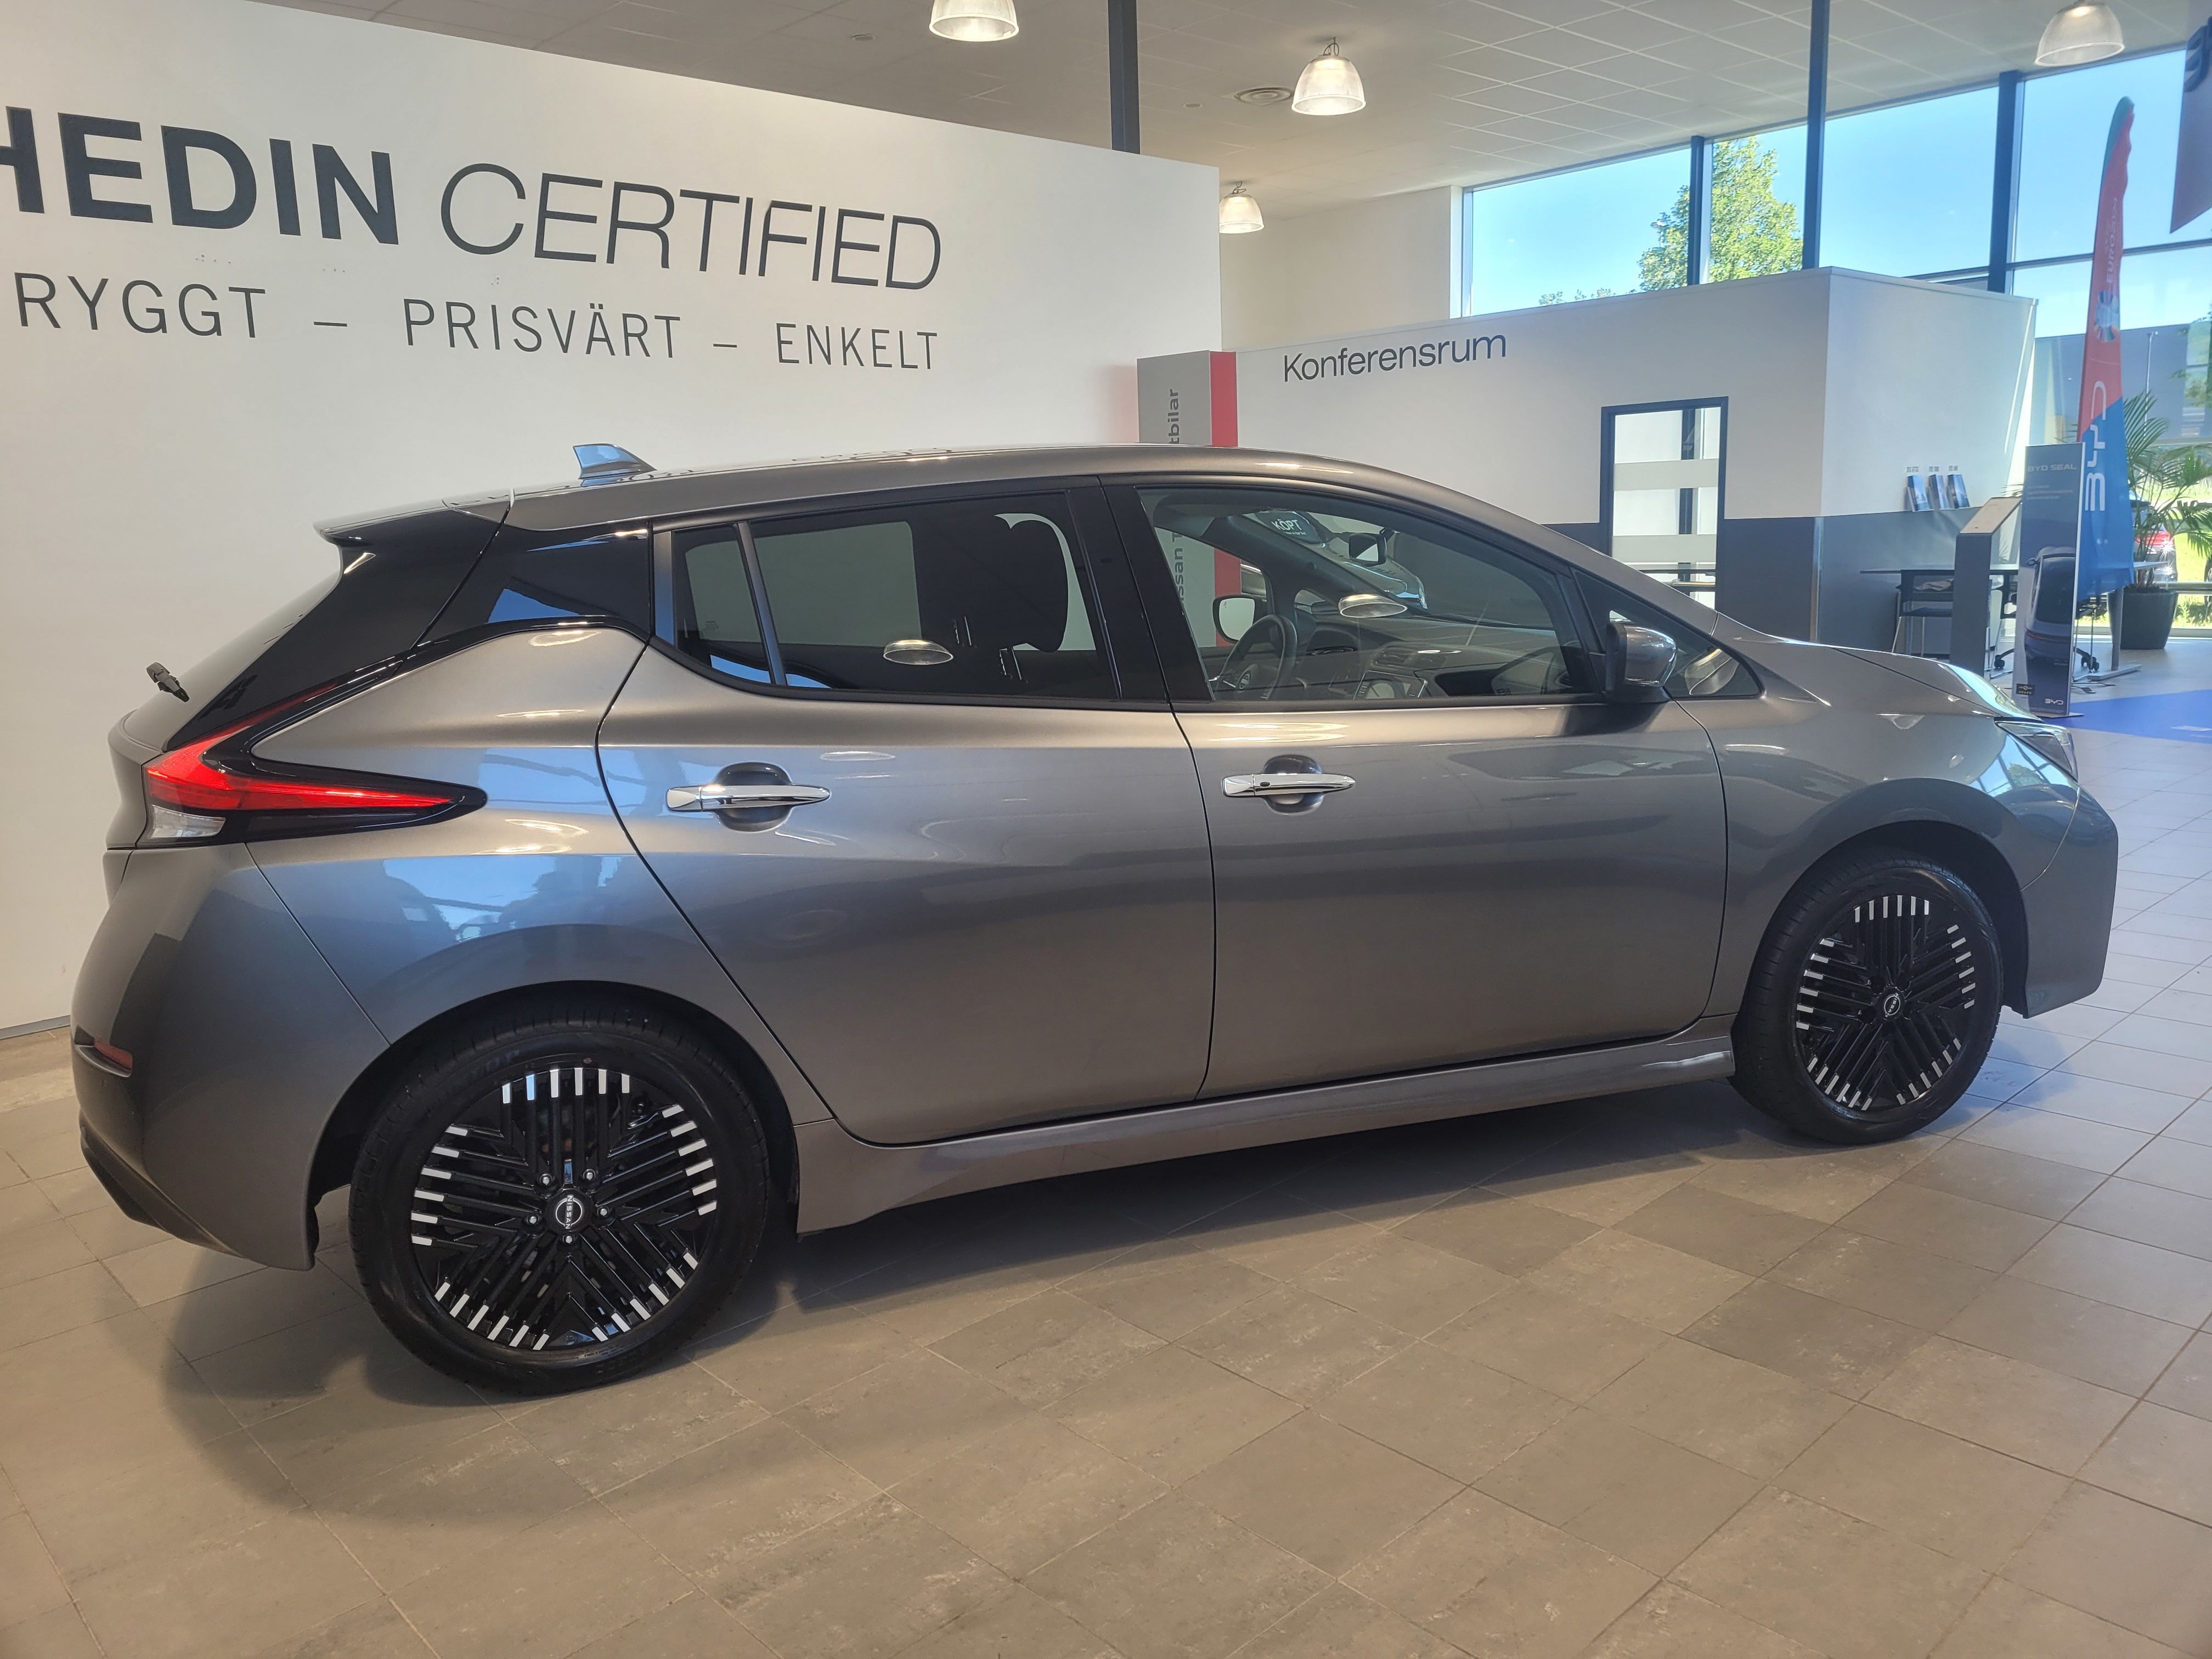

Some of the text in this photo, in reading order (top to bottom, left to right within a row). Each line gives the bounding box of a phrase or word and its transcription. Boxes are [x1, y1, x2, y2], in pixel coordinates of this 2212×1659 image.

[441, 163, 941, 290] CERTIFIED
[14, 272, 266, 338] RYGGT
[403, 298, 681, 358] PRISVÄRT
[776, 323, 938, 369] ENKELT
[1284, 334, 1506, 382] Konferensrum
[565, 1195, 574, 1229] NISSAN
